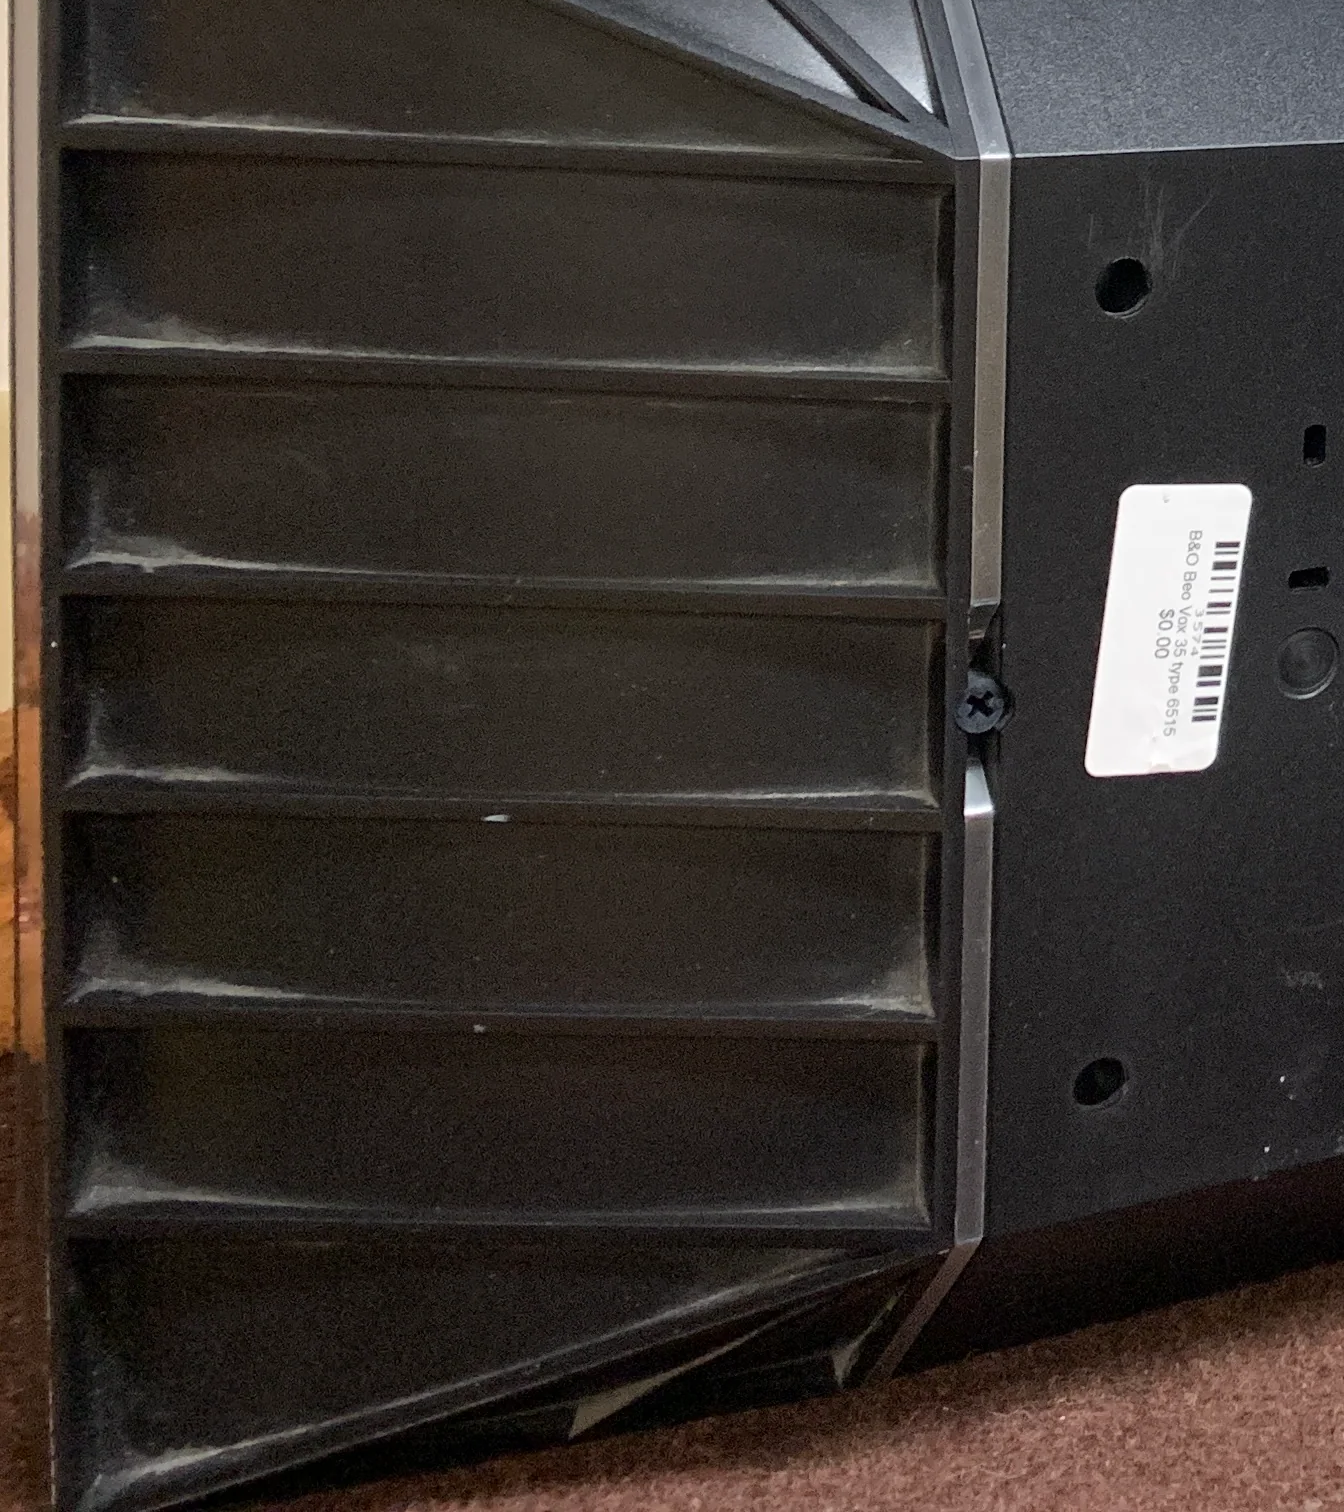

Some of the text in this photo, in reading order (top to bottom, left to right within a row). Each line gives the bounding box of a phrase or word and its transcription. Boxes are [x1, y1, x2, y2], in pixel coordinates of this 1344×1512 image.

[1185, 529, 1203, 567] B&O
[1180, 570, 1197, 601] Beo
[1154, 608, 1175, 659] $0.00
[1173, 639, 1187, 658] 35
[1190, 608, 1204, 657] 3574
[1167, 660, 1184, 695] type
[1163, 698, 1180, 737] 6515
